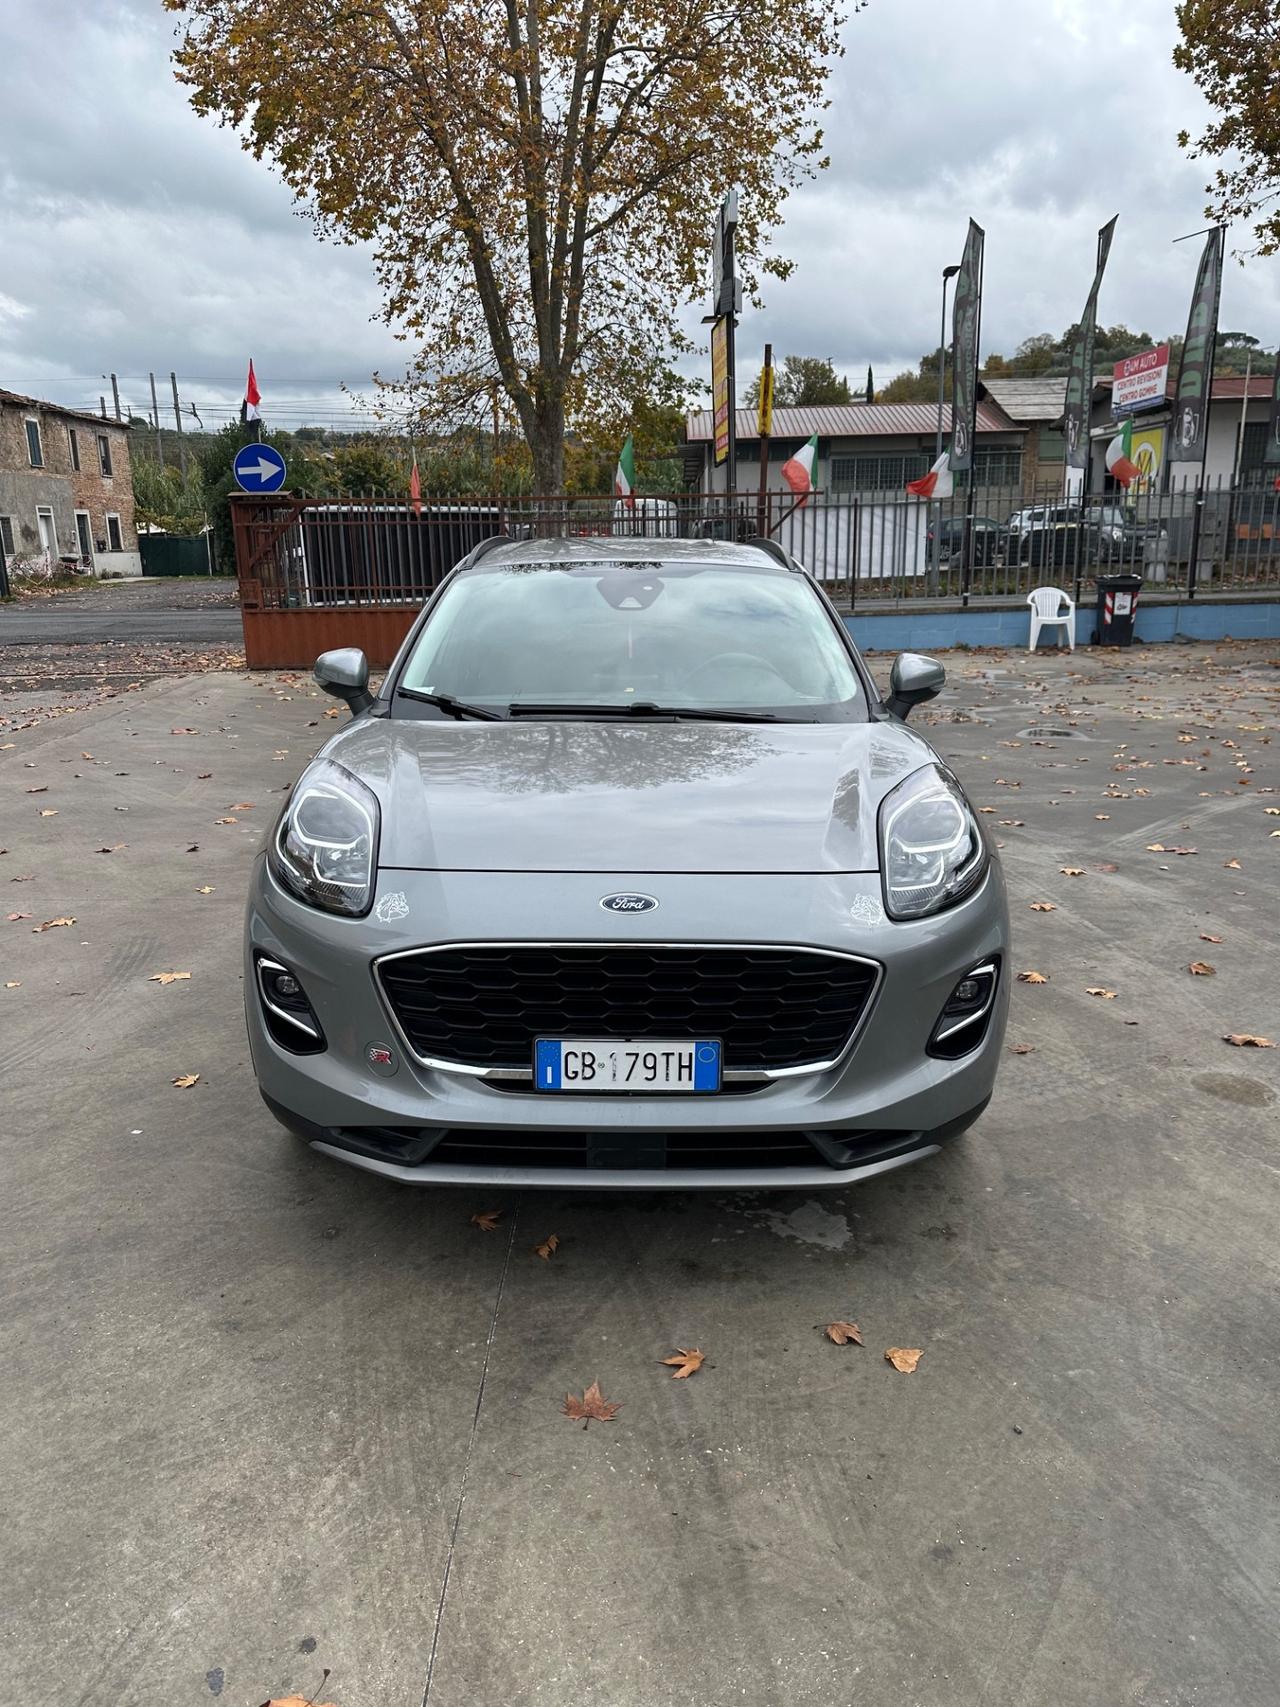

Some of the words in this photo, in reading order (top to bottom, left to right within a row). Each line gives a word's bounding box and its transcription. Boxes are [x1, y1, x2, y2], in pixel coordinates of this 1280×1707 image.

[1139, 353, 1158, 370] AUTO
[1117, 377, 1136, 391] CENTRO
[1120, 390, 1138, 403] CENTRO
[612, 896, 645, 909] Ford
